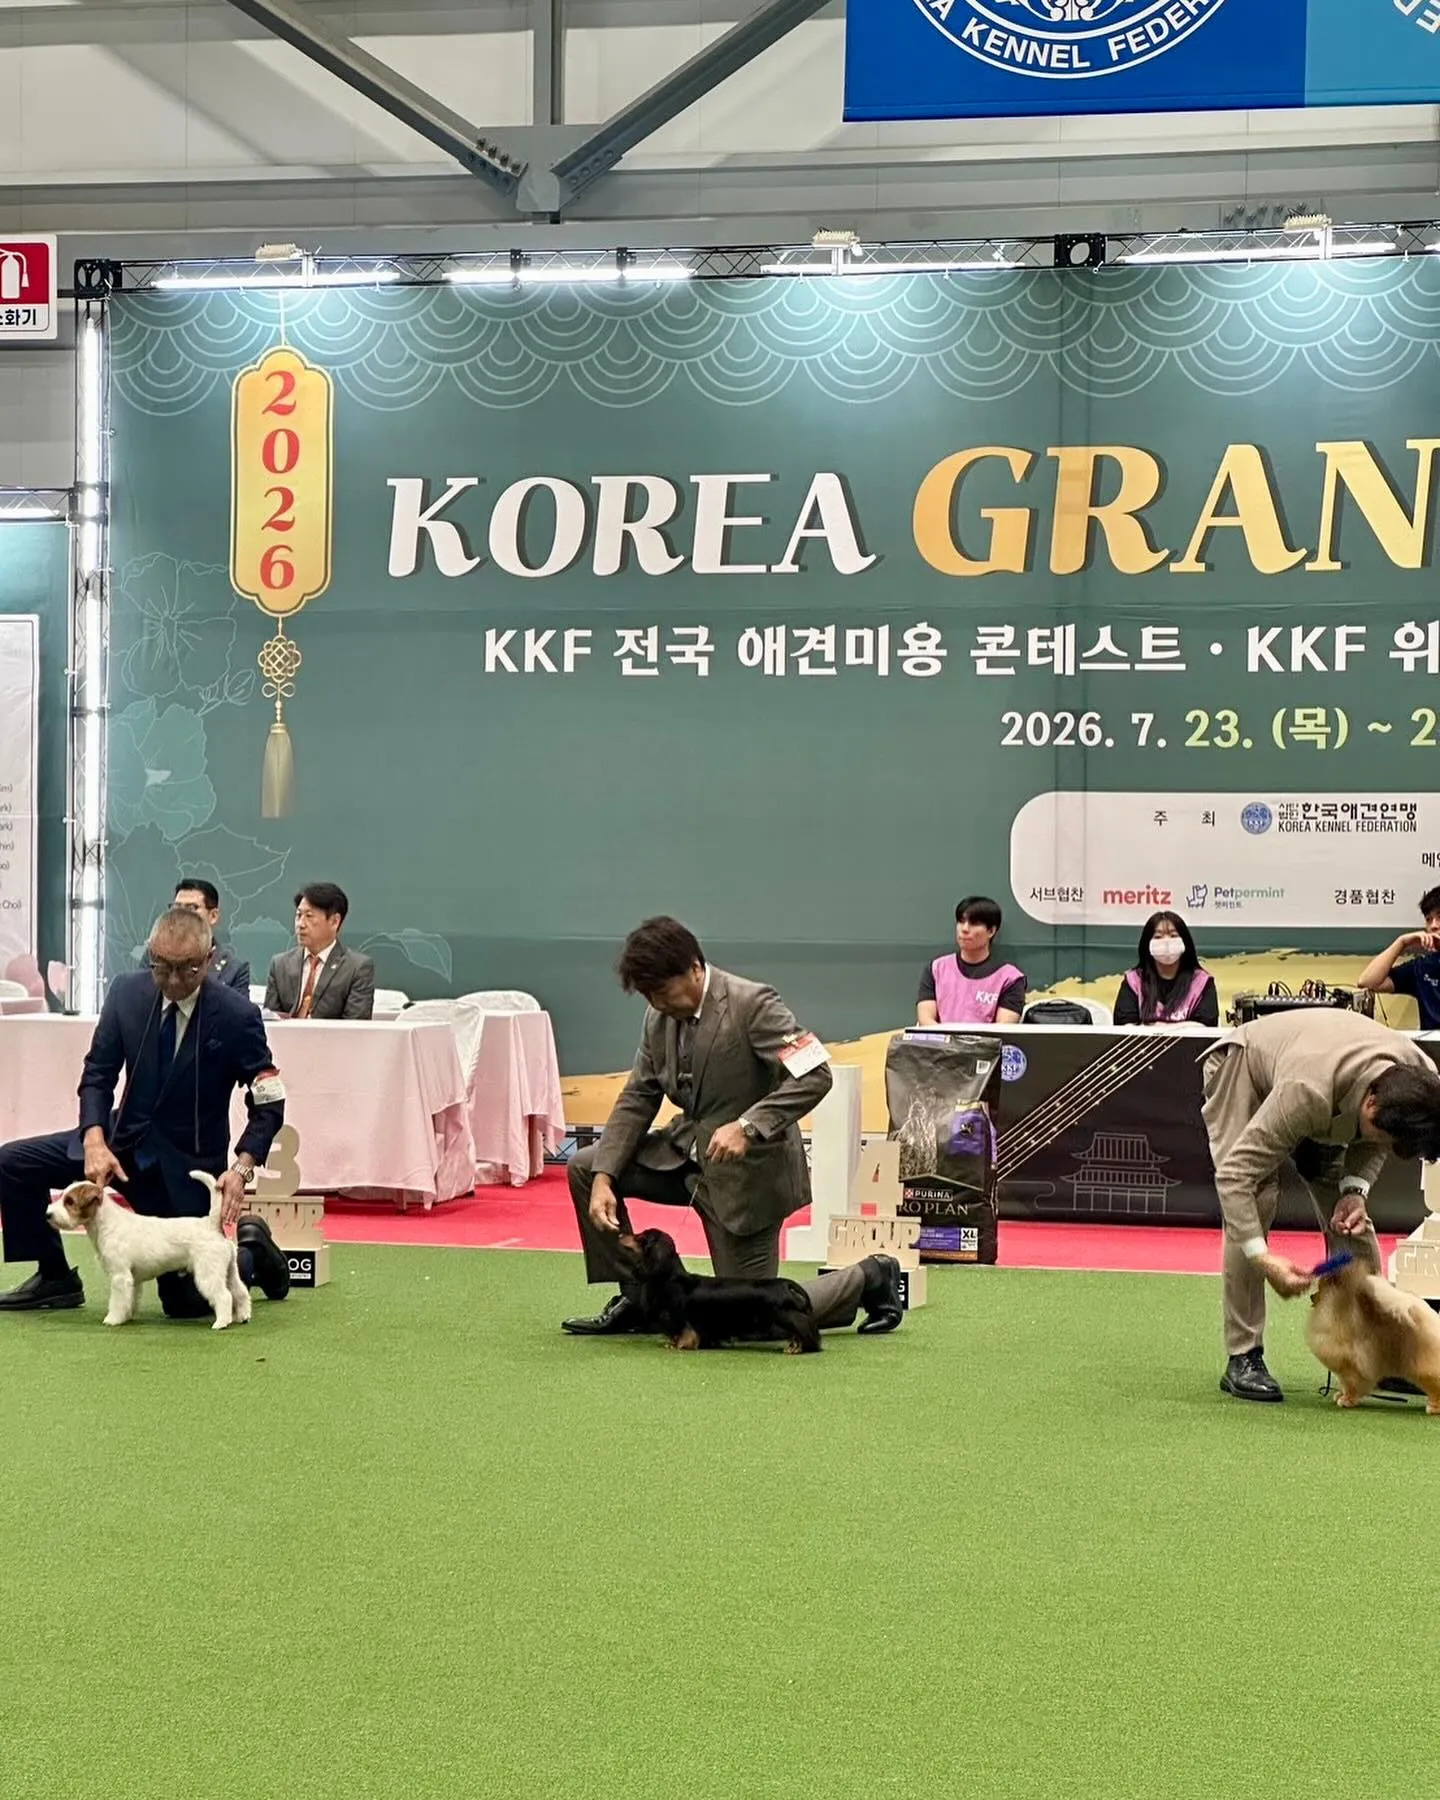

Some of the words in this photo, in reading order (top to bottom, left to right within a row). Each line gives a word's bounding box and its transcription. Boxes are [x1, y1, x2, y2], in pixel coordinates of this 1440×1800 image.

[961, 16, 1090, 69] KENNEL
[260, 370, 300, 590] 2026
[386, 471, 880, 578] KOREA
[912, 439, 1440, 577] GRAN
[484, 627, 593, 674] KKF
[613, 624, 716, 677] 전국
[737, 621, 948, 678] 애견미용
[969, 622, 1187, 677] 콘테스트
[1246, 625, 1367, 674] KKF
[1389, 619, 1440, 675] 위
[1000, 710, 1115, 748] 2026.
[1131, 712, 1167, 748] 7.
[1184, 708, 1254, 749] 23.
[1271, 706, 1350, 750] (목)
[1410, 707, 1440, 747] 2
[1153, 809, 1169, 827] 주
[1201, 809, 1216, 827] 최
[1302, 801, 1417, 821] 한국애견연맹
[1278, 821, 1311, 832] KOREA
[1315, 821, 1352, 832] KENNEL
[1356, 821, 1417, 832] FEDERATION
[1030, 886, 1084, 903] 서브협찬
[1102, 885, 1172, 905] meritz
[1214, 886, 1285, 900] Petpermint
[1334, 888, 1396, 905] 경품협찬
[914, 1189, 951, 1198] PURINA
[899, 1200, 922, 1214] RO
[924, 1201, 969, 1216] PLAN
[962, 1229, 977, 1239] XL
[287, 1257, 312, 1271] OG
